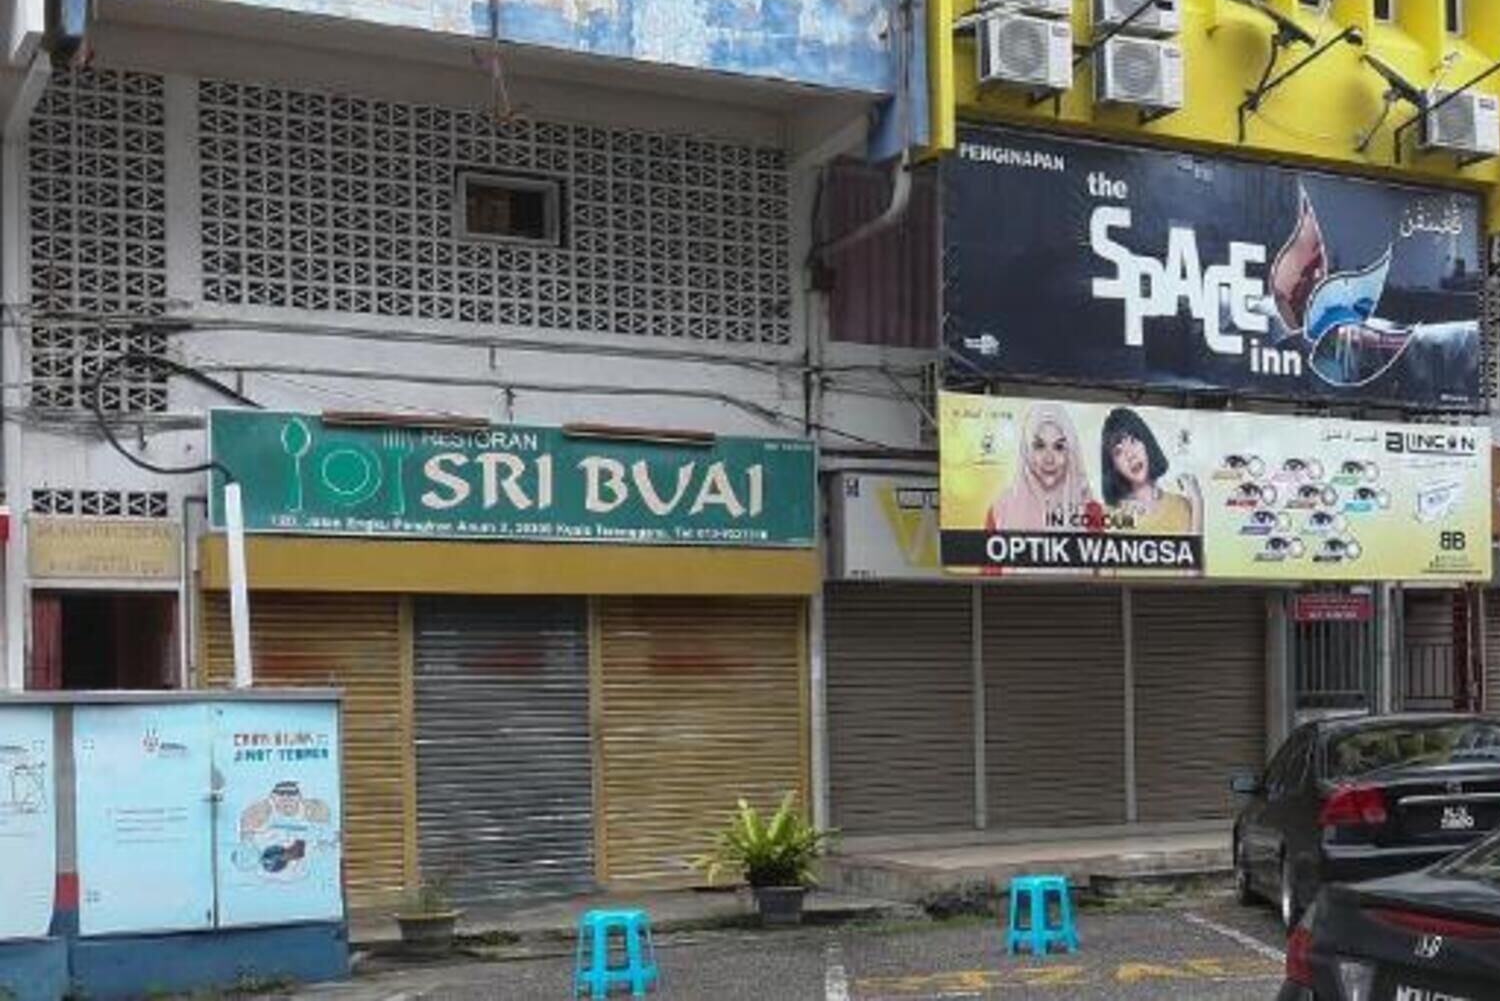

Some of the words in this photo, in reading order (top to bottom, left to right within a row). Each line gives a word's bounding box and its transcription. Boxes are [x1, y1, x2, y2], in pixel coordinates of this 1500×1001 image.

[959, 142, 1065, 173] PENGINAPAN
[1086, 171, 1128, 199] the
[1249, 338, 1302, 376] inn
[423, 430, 539, 451] RESTORAN
[420, 452, 553, 512] SRI
[986, 536, 1071, 562] OPTIK
[1077, 537, 1196, 565] WANGSA
